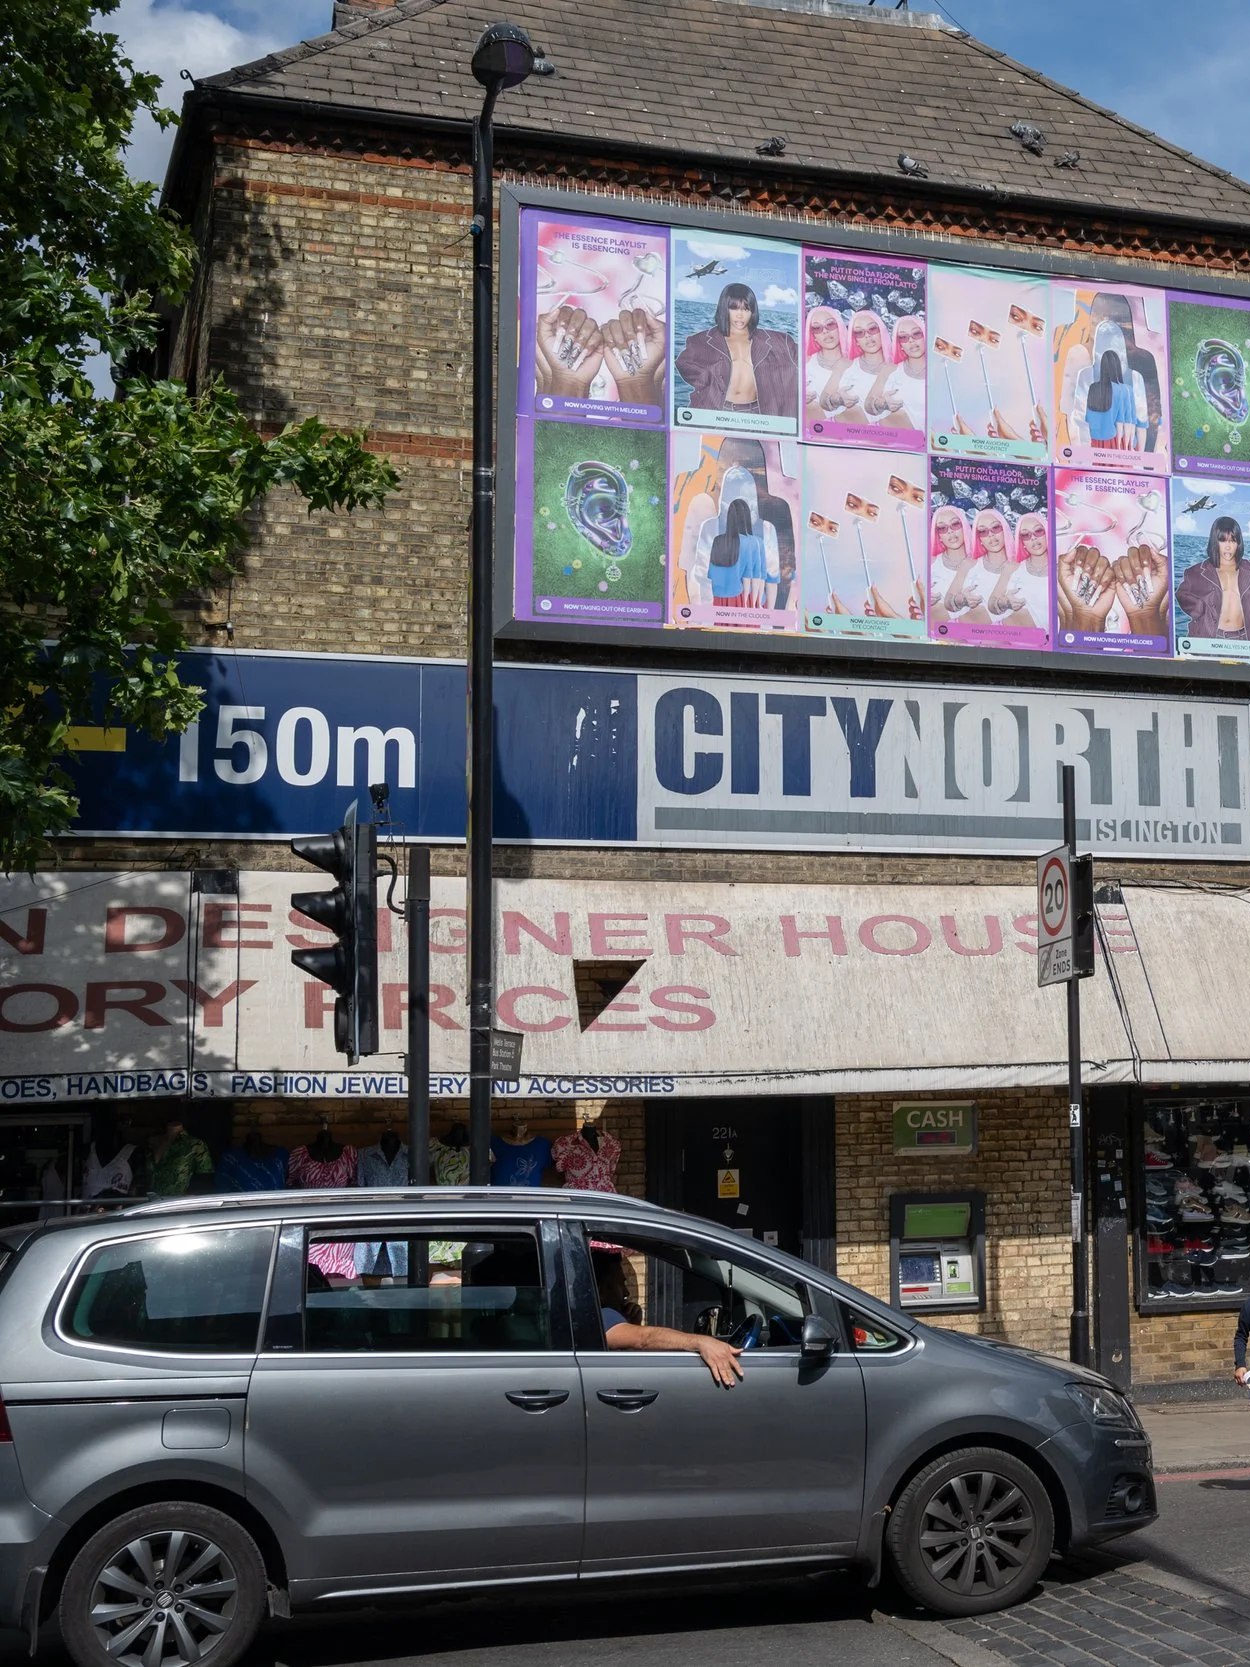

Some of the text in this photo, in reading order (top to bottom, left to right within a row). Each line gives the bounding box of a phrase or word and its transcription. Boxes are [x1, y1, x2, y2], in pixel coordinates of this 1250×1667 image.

[554, 231, 648, 250] THE ESSENCE PLAYLIST
[572, 242, 630, 255] IS ESSENCING
[814, 271, 918, 289] THE NEW SINGLE FROM LATTO
[580, 403, 604, 411] MOVING
[620, 407, 648, 415] MELODIES
[955, 465, 968, 473] PUT
[939, 470, 953, 478] THE
[954, 472, 970, 480] NEW
[971, 474, 996, 482] SINGLE
[997, 476, 1017, 484] FROM
[1072, 475, 1149, 488] THE ESSENCE PLAYLIST
[1095, 485, 1136, 495] ESSENCING
[179, 704, 417, 789] 150m
[1090, 818, 1224, 844] ISLINGTON
[1045, 878, 1064, 915] 20
[1056, 949, 1067, 959] Zone
[1053, 959, 1070, 976] ENDS
[67, 1072, 215, 1098] HANDBAGS,
[232, 1075, 326, 1095] FASHION
[335, 1076, 468, 1095] JEWELERY
[528, 1076, 676, 1094] ACCESSORIES
[907, 1109, 964, 1128] CASH
[712, 1127, 738, 1139] 221A
